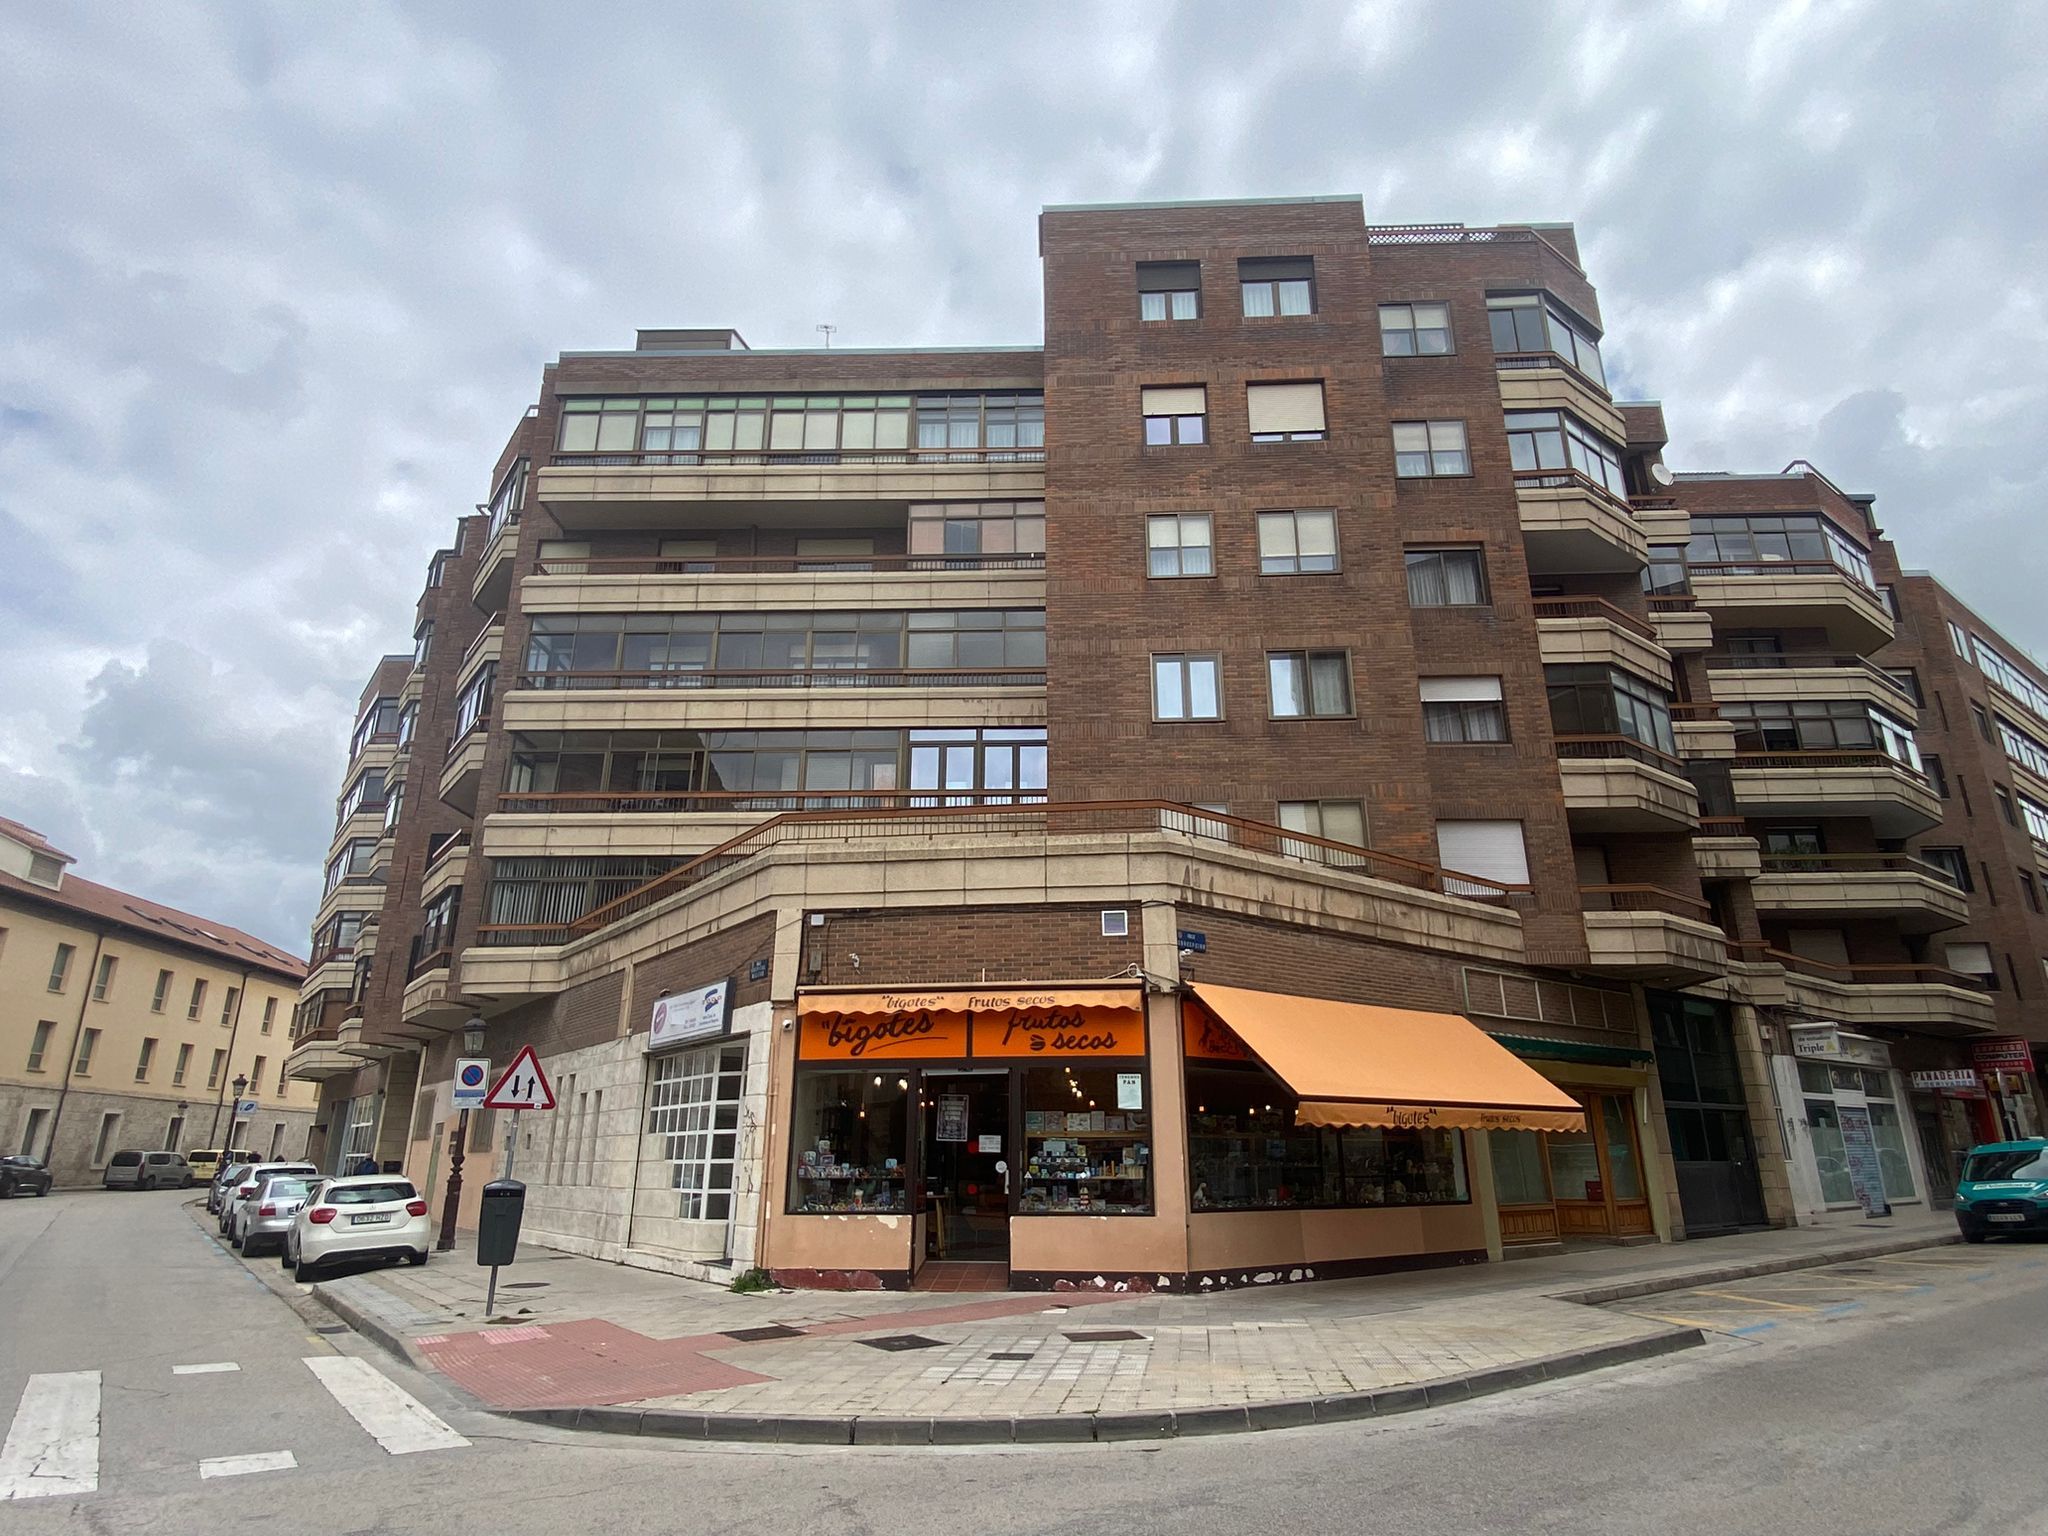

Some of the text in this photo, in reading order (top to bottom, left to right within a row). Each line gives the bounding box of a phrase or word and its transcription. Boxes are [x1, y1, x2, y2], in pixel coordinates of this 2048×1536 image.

[1016, 995, 1056, 1006] secos
[1002, 1008, 1086, 1046] frutos
[1050, 1031, 1118, 1050] secos
[1797, 1042, 1825, 1054] Triple
[1975, 1052, 2026, 1060] COMPUTER
[1912, 1070, 1972, 1081] PANADERIA
